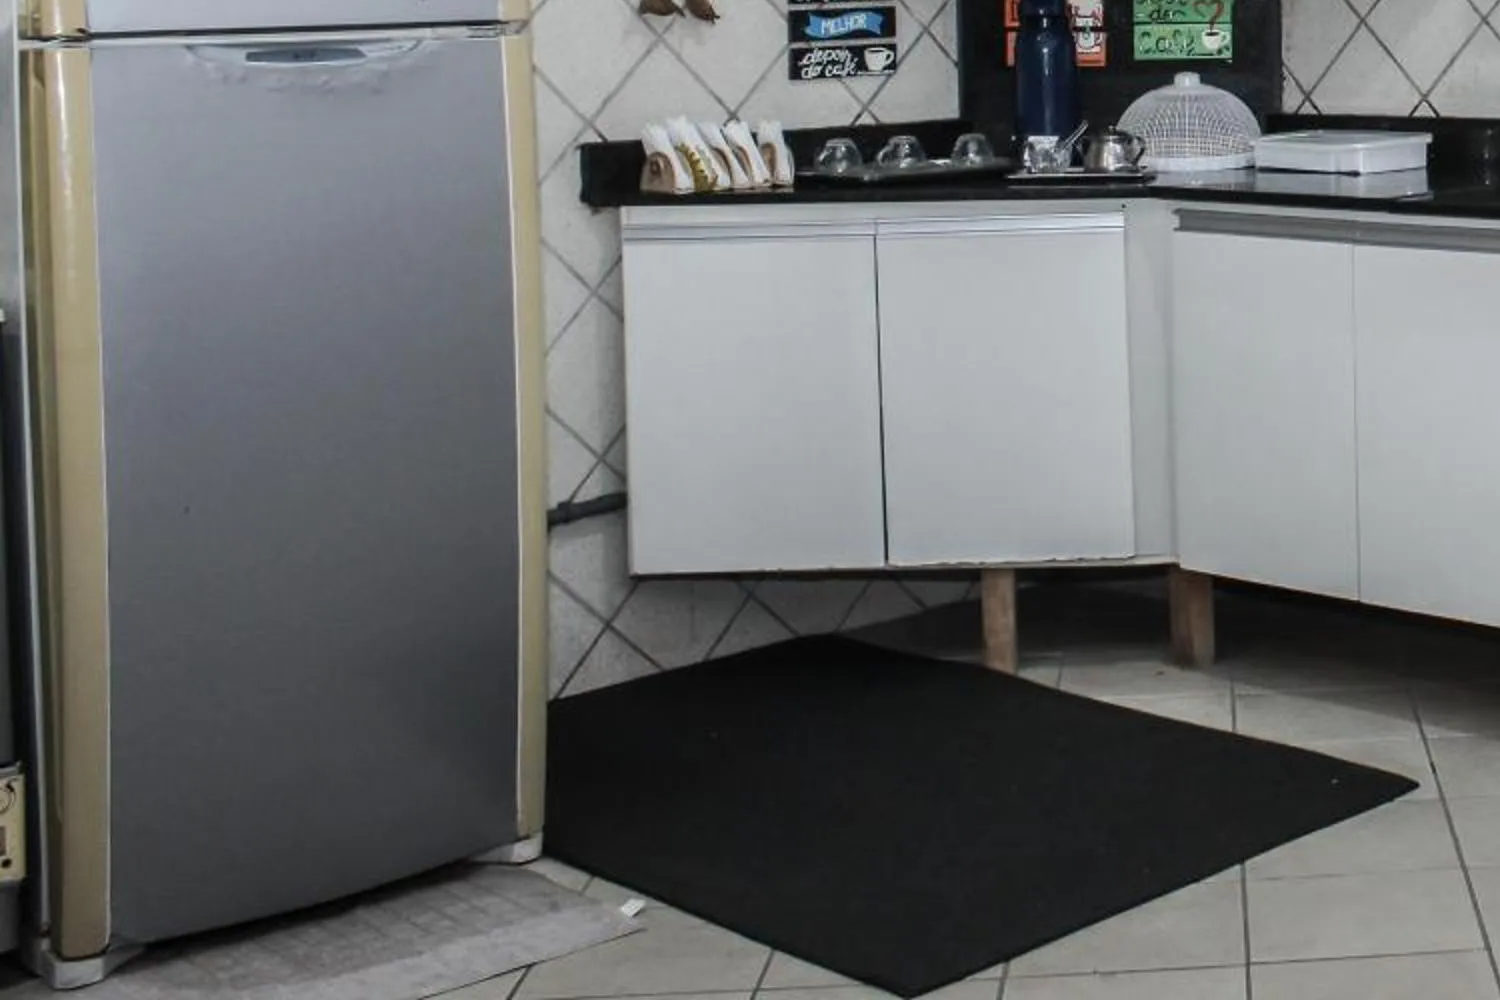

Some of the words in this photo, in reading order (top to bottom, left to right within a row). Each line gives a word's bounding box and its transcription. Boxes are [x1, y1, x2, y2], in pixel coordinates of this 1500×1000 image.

[821, 13, 867, 36] MELHOR
[801, 64, 823, 79] do
[824, 57, 859, 78] café
